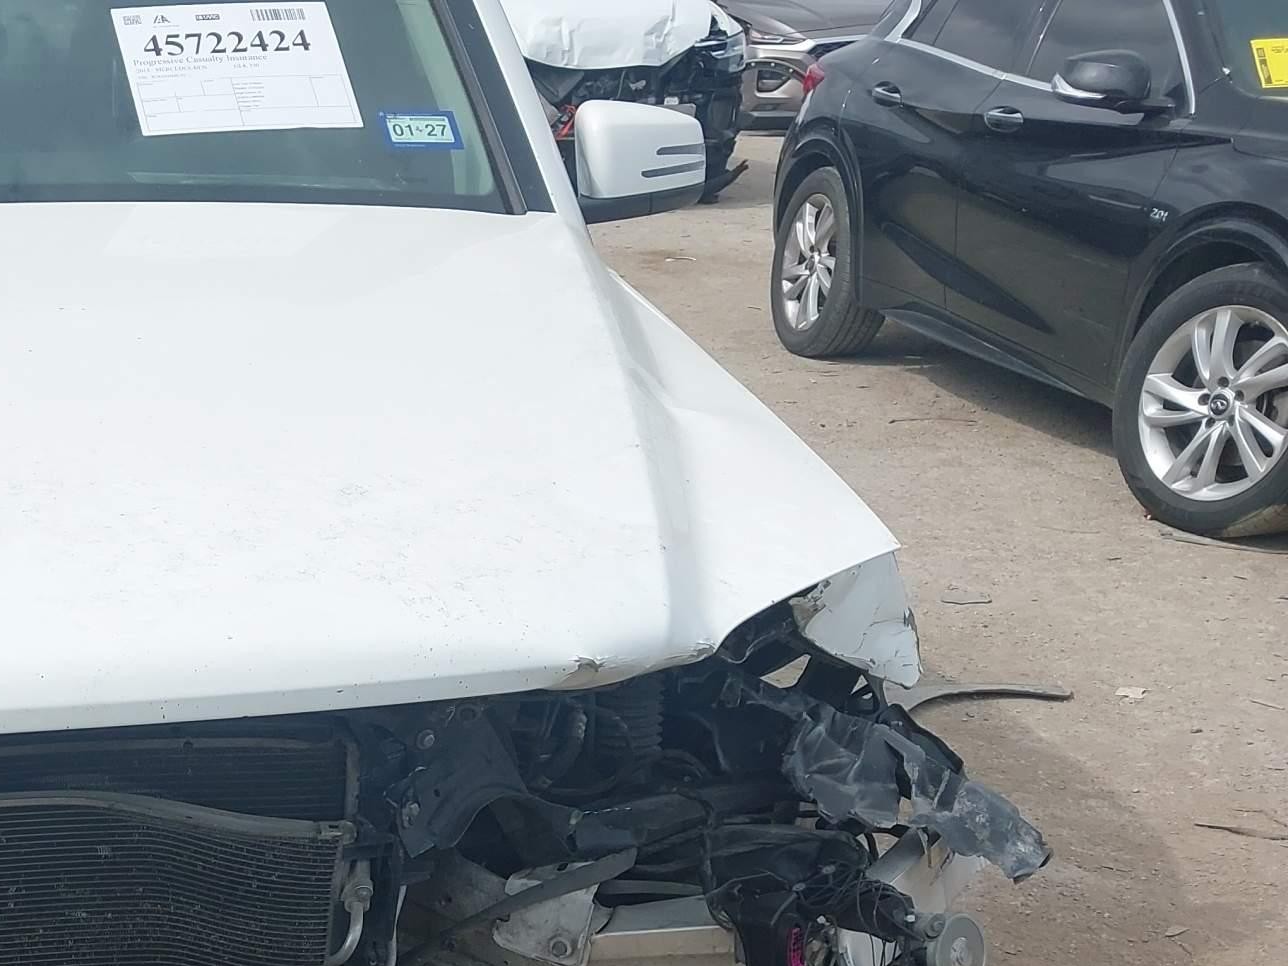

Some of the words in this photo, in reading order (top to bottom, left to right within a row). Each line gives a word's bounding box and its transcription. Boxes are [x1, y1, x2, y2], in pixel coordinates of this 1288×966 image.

[143, 30, 311, 56] 45722424
[133, 57, 184, 66] Progressive
[186, 55, 223, 64] Casualty
[226, 54, 268, 62] Insurance
[392, 123, 415, 137] 01
[425, 123, 447, 137] 27
